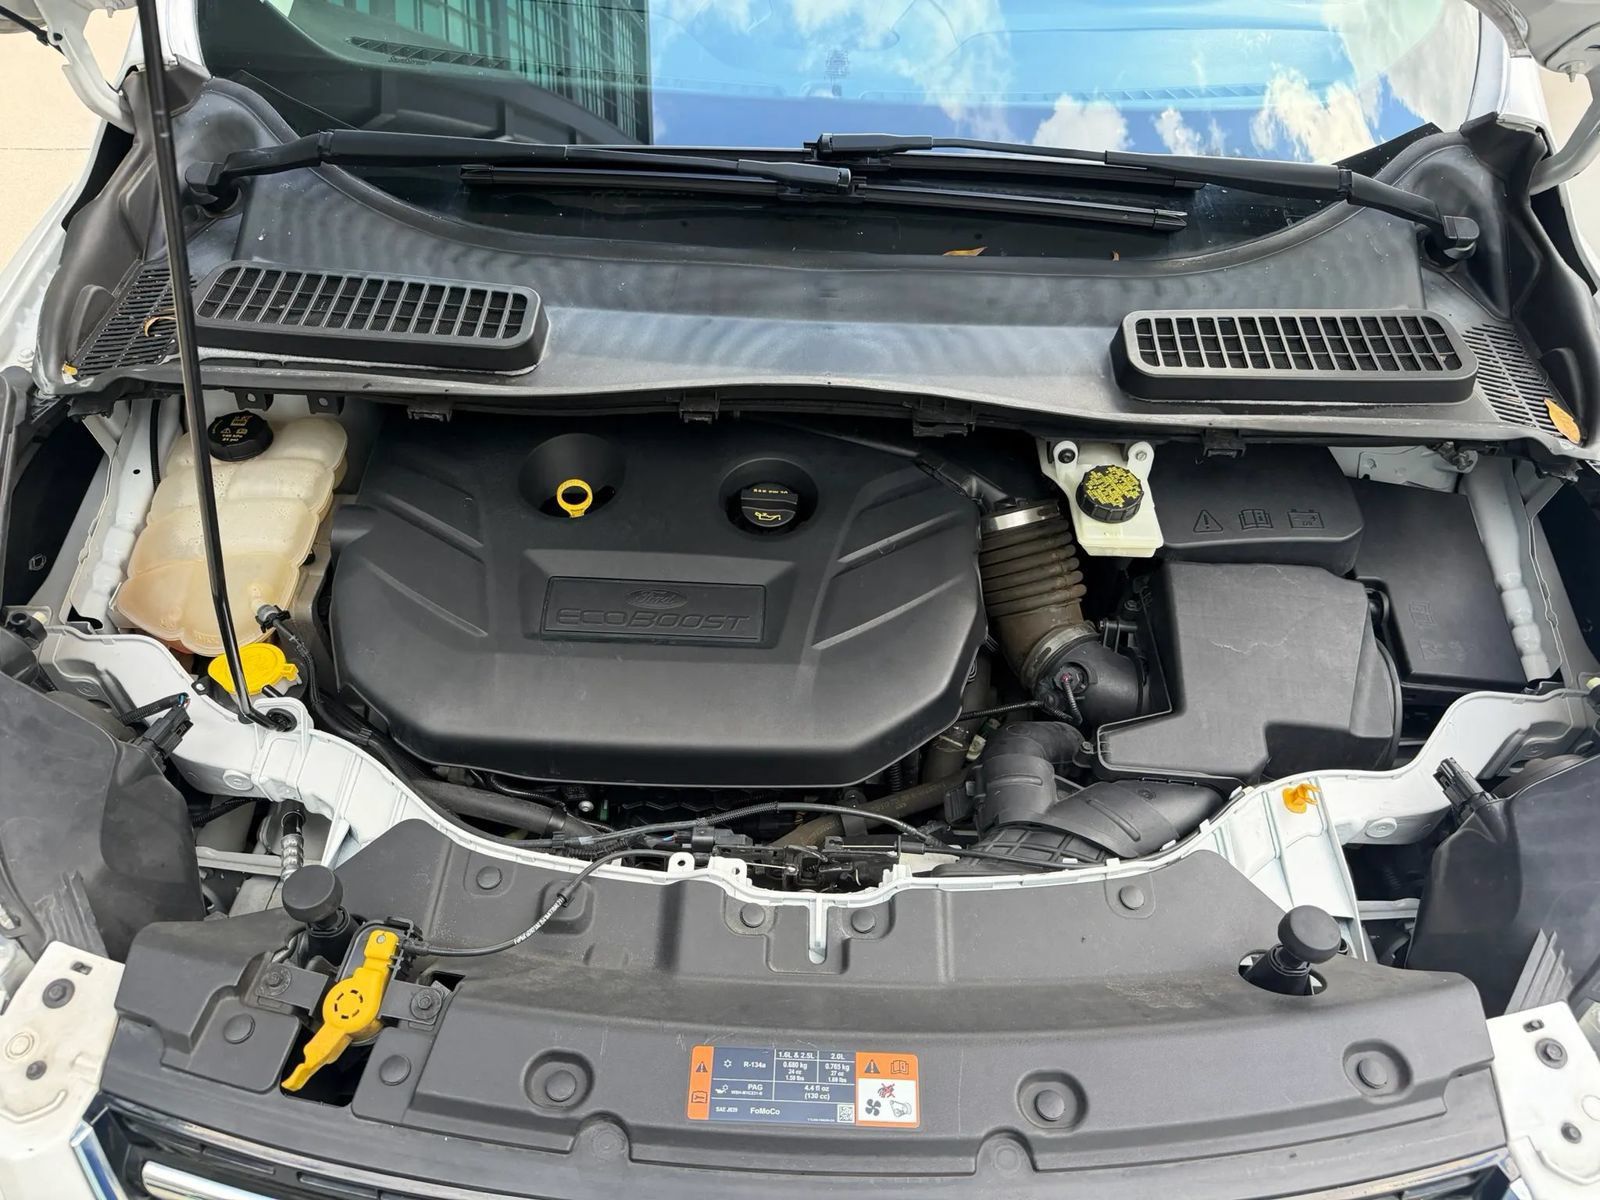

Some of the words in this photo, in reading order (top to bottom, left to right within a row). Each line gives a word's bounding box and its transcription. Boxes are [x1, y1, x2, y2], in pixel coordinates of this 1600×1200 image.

[635, 589, 676, 605] Ford
[799, 1062, 808, 1070] kg
[841, 1064, 850, 1072] kg
[747, 1083, 763, 1091] PAG
[804, 1092, 819, 1100] (130
[750, 1107, 781, 1115] FoMoCo
